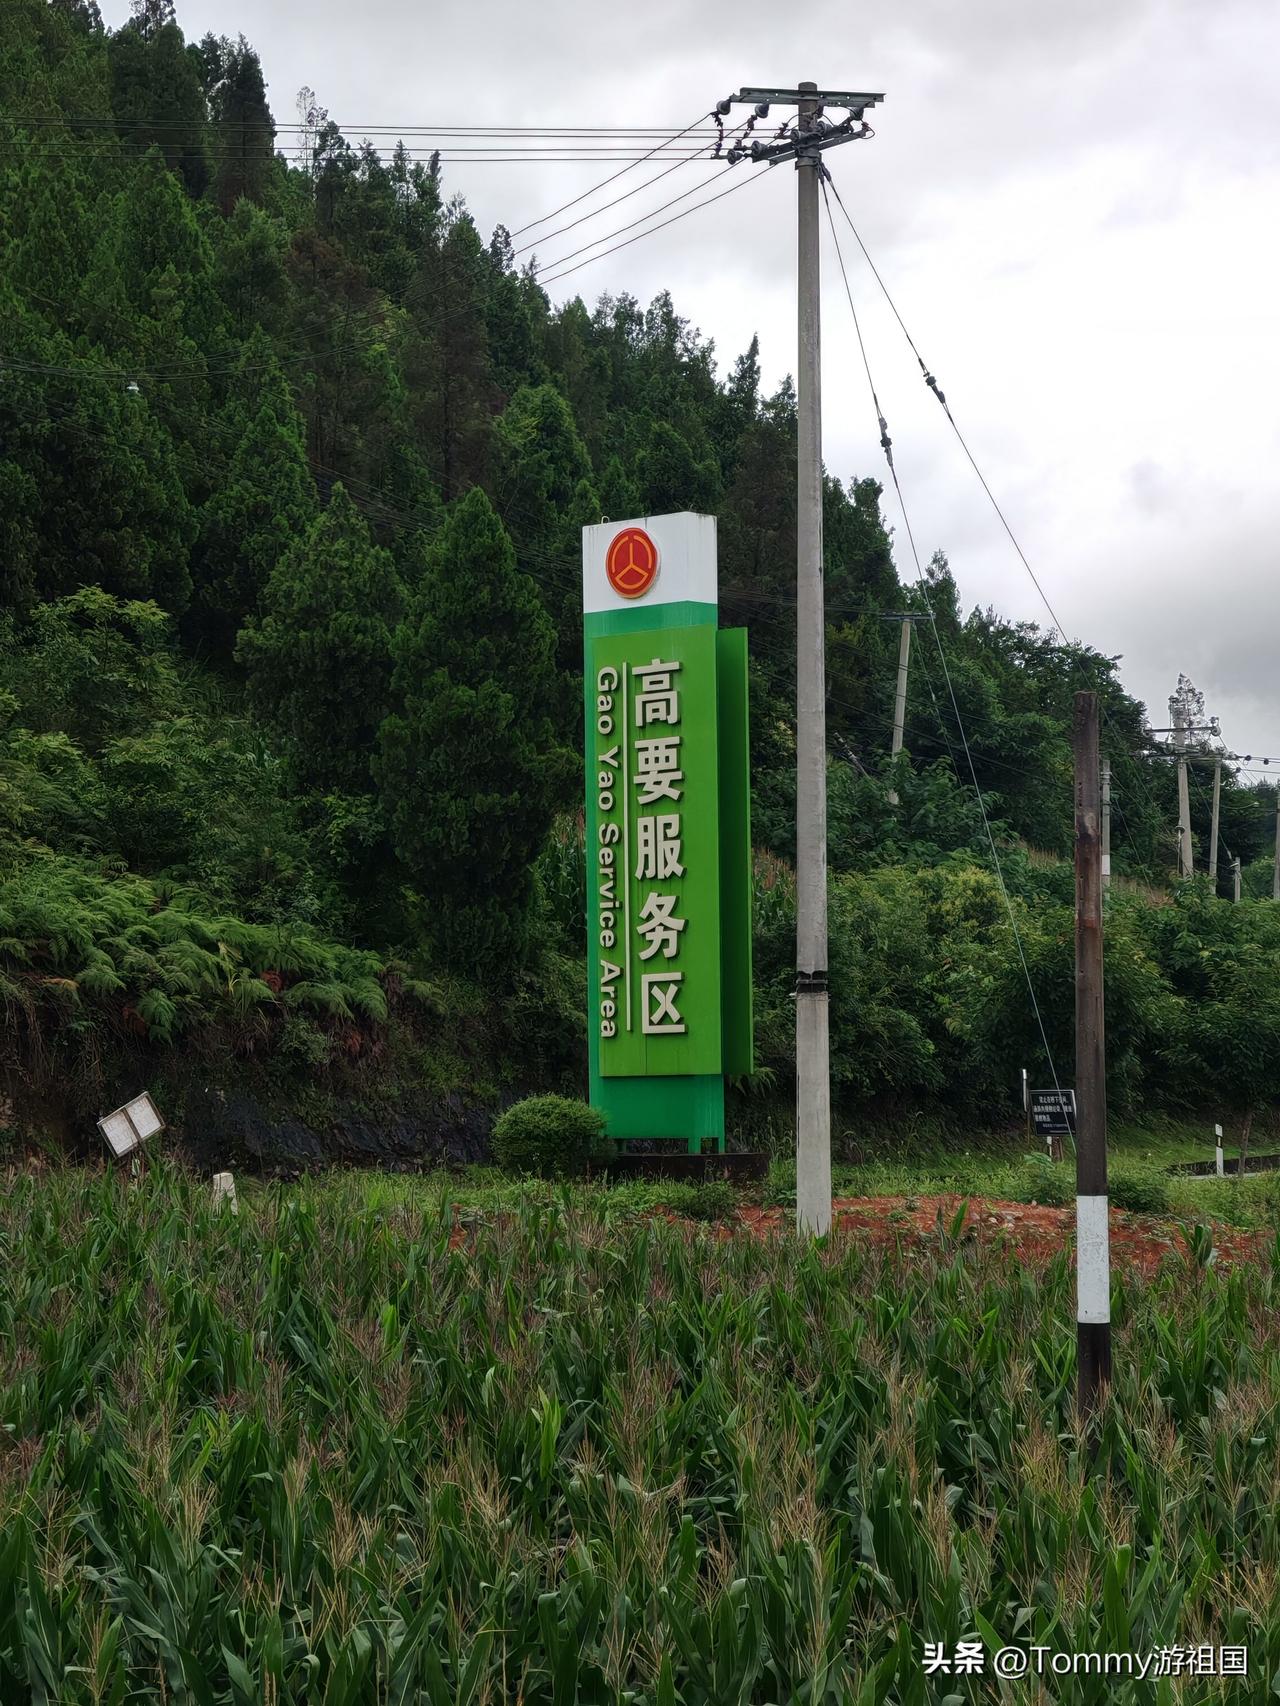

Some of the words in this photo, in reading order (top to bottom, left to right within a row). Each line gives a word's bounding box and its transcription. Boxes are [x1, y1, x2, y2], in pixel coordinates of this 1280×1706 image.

[597, 667, 619, 735] Gao
[598, 746, 619, 811] Yao
[598, 823, 620, 948] Service
[631, 658, 687, 1035] 高要服务区
[600, 959, 622, 1037] Area
